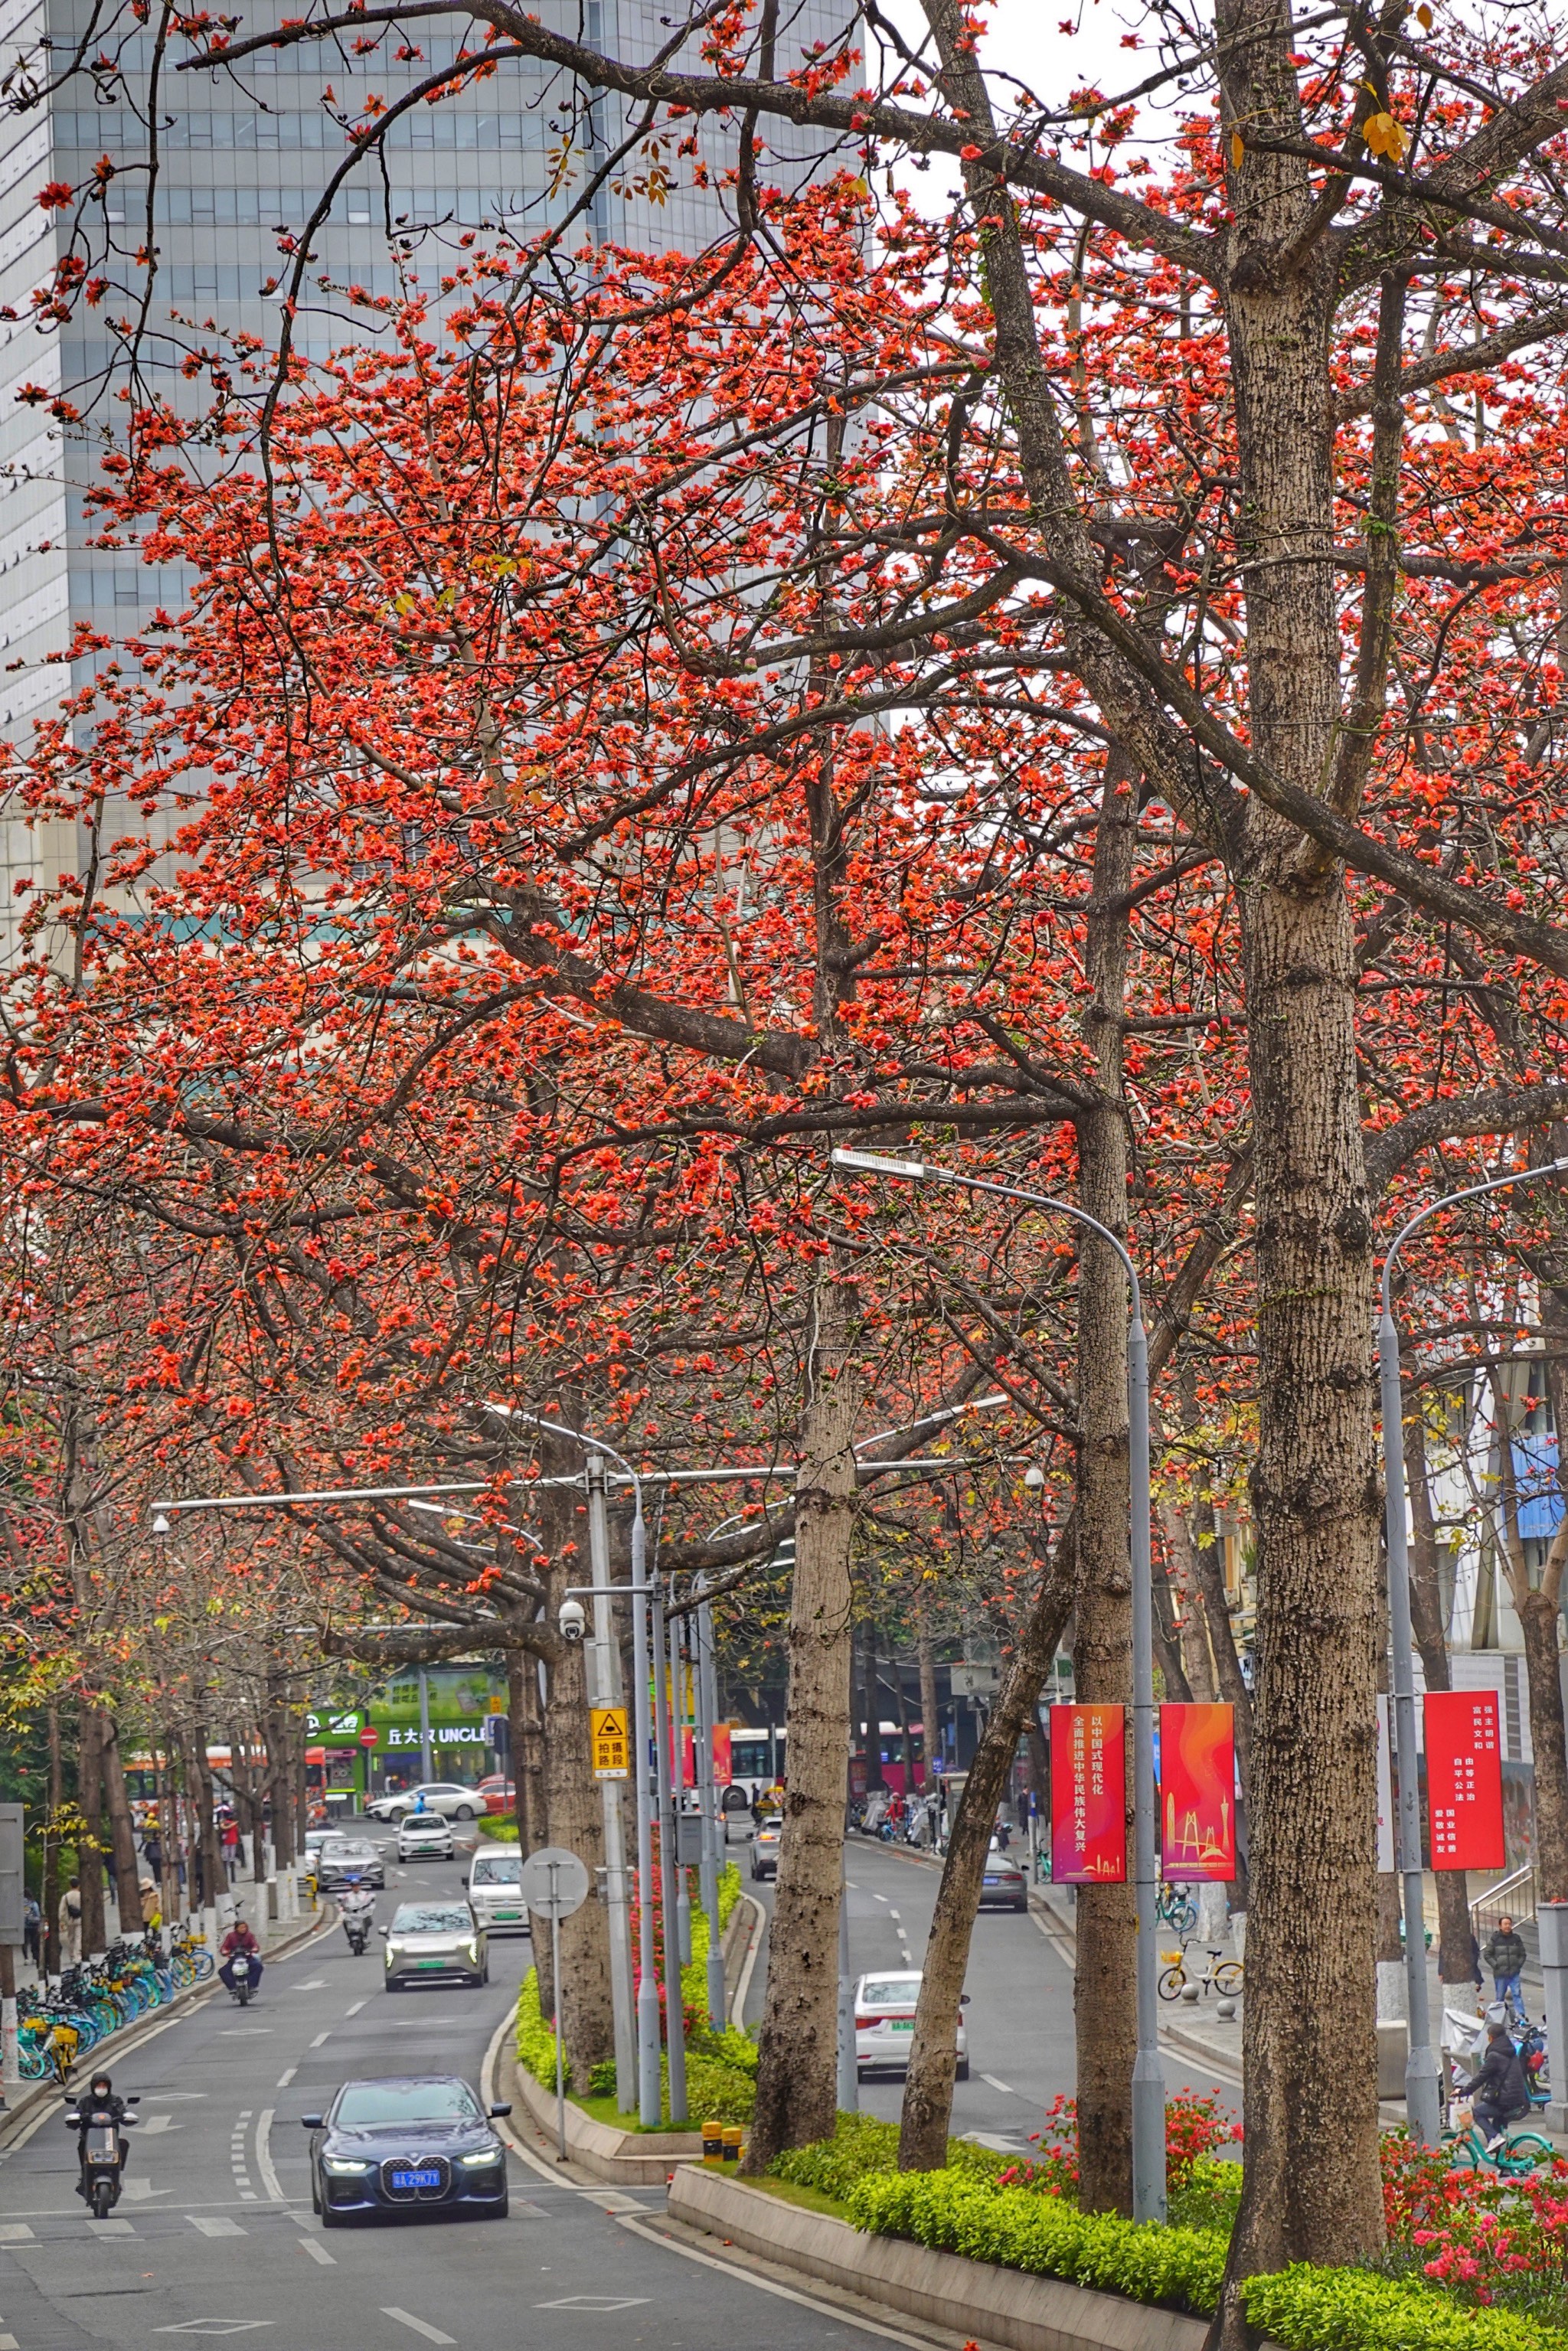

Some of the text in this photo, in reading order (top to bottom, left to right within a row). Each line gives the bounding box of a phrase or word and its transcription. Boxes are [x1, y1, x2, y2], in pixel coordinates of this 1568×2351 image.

[1472, 1706, 1493, 1714] 富强
[1473, 1718, 1494, 1726] 民主
[1473, 1729, 1494, 1738] 文明
[599, 1742, 622, 1753] 拍摄
[1474, 1741, 1494, 1749] 和谐
[1091, 1716, 1103, 1795] 以中国式现代化
[599, 1755, 624, 1766] 路段
[1454, 1758, 1474, 1766] 自由
[1454, 1769, 1475, 1778] 平等
[1073, 1716, 1086, 1853] 全面推进中华民族伟大复兴
[1455, 1781, 1475, 1789] 公正
[1455, 1793, 1475, 1801] 法治
[1435, 1809, 1455, 1817] 爱国
[1436, 1833, 1456, 1841] 诚信
[1436, 1844, 1456, 1853] 友善
